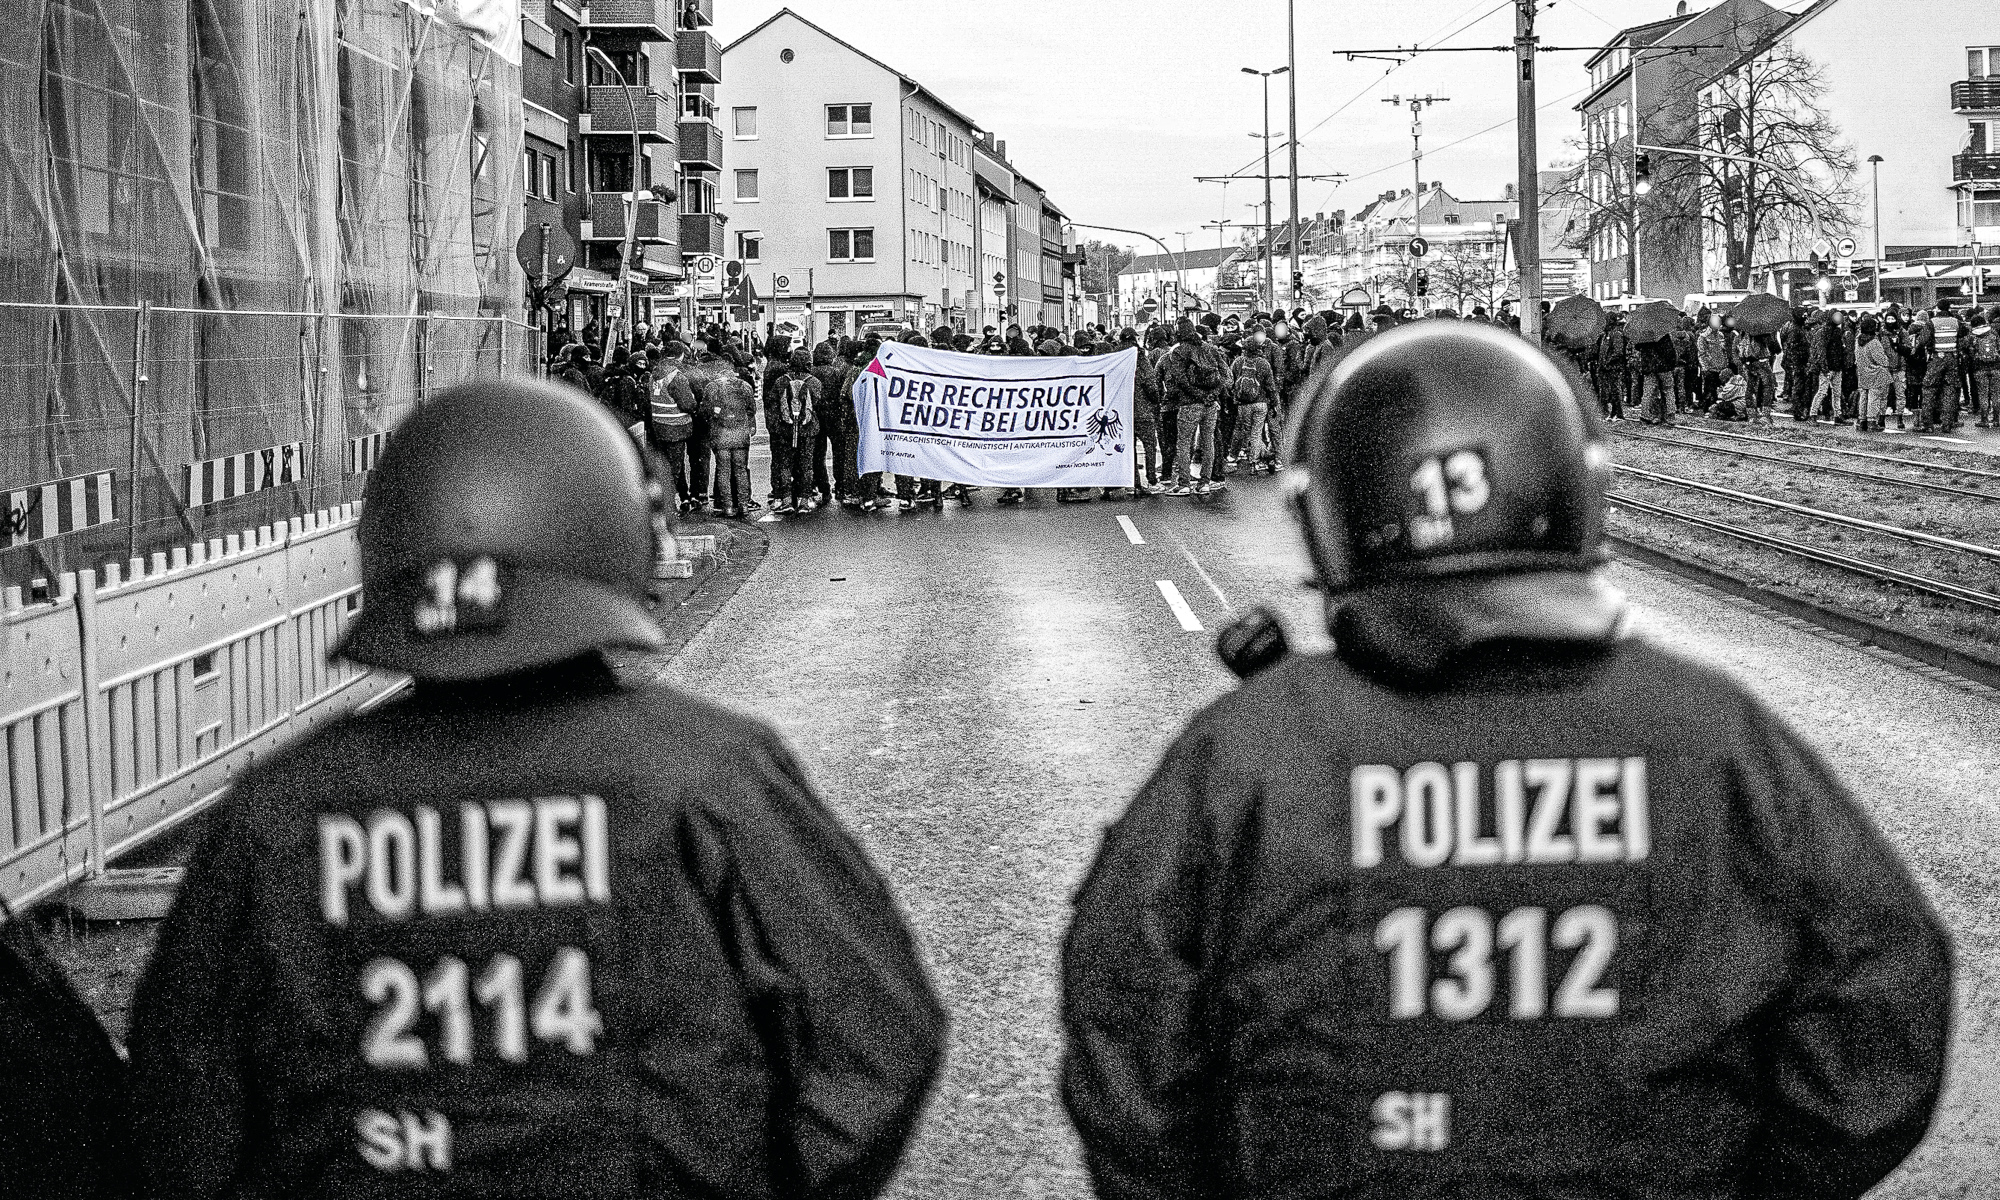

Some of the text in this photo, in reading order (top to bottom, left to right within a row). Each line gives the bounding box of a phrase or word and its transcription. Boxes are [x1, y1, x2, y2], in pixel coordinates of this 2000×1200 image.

[888, 376, 1094, 410] DER RECHTSRUCK
[900, 402, 1081, 432] ENDET BEI UNS!
[883, 434, 952, 446] ANTIFASCHISTISCH
[957, 440, 1009, 450] FEMINISTISCH
[1013, 440, 1087, 449] ANTIKAPITALISTISCH
[1410, 453, 1489, 512] 13
[422, 558, 501, 608] 14
[1350, 756, 1650, 868] POLIZEI
[319, 794, 611, 926] POLIZEI
[1373, 904, 1620, 1020] 1312
[361, 945, 602, 1068] 2114
[355, 1108, 452, 1172] SH
[1371, 1090, 1451, 1152] SH
